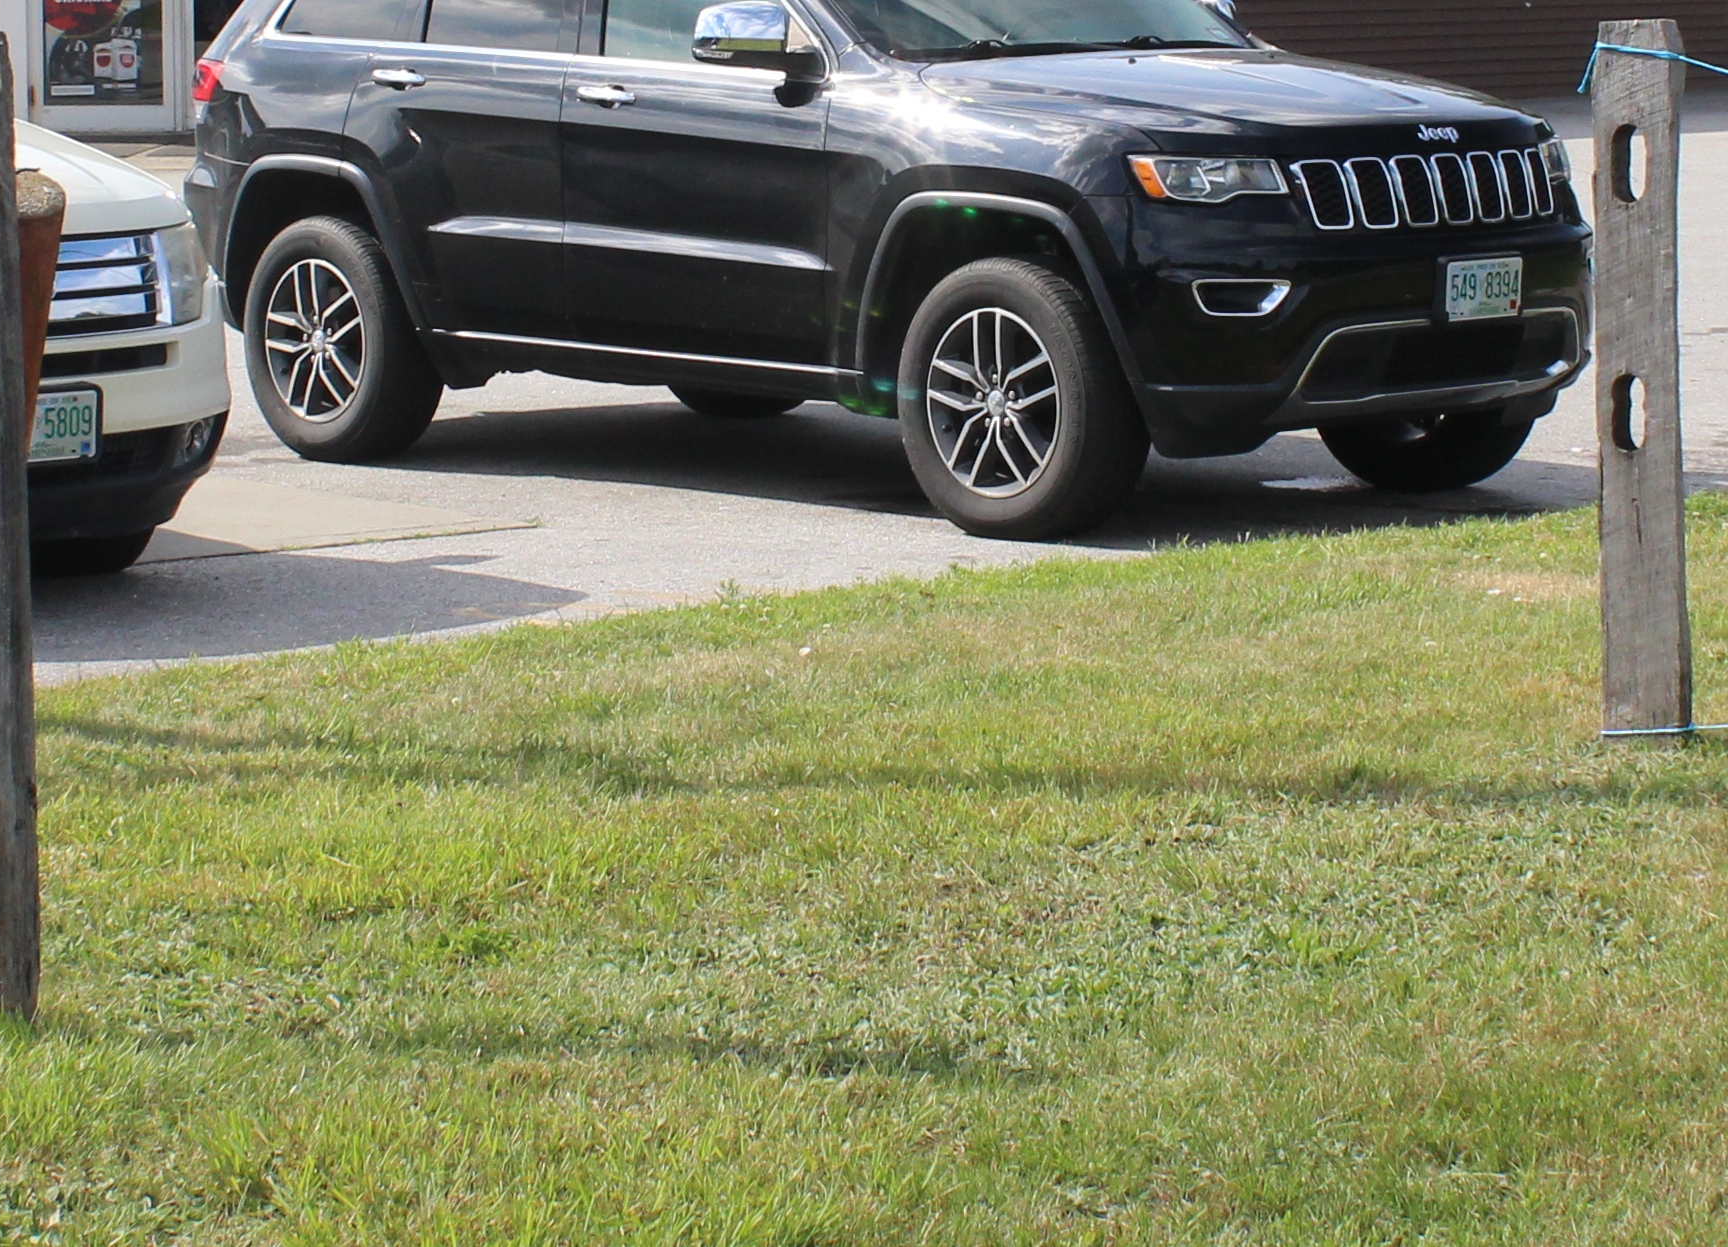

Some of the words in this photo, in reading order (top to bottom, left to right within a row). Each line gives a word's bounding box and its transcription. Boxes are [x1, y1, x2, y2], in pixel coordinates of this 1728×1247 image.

[1417, 124, 1459, 143] Jeep
[1451, 273, 1477, 302] 549
[1485, 269, 1520, 299] 8394
[44, 406, 92, 439] 5809
